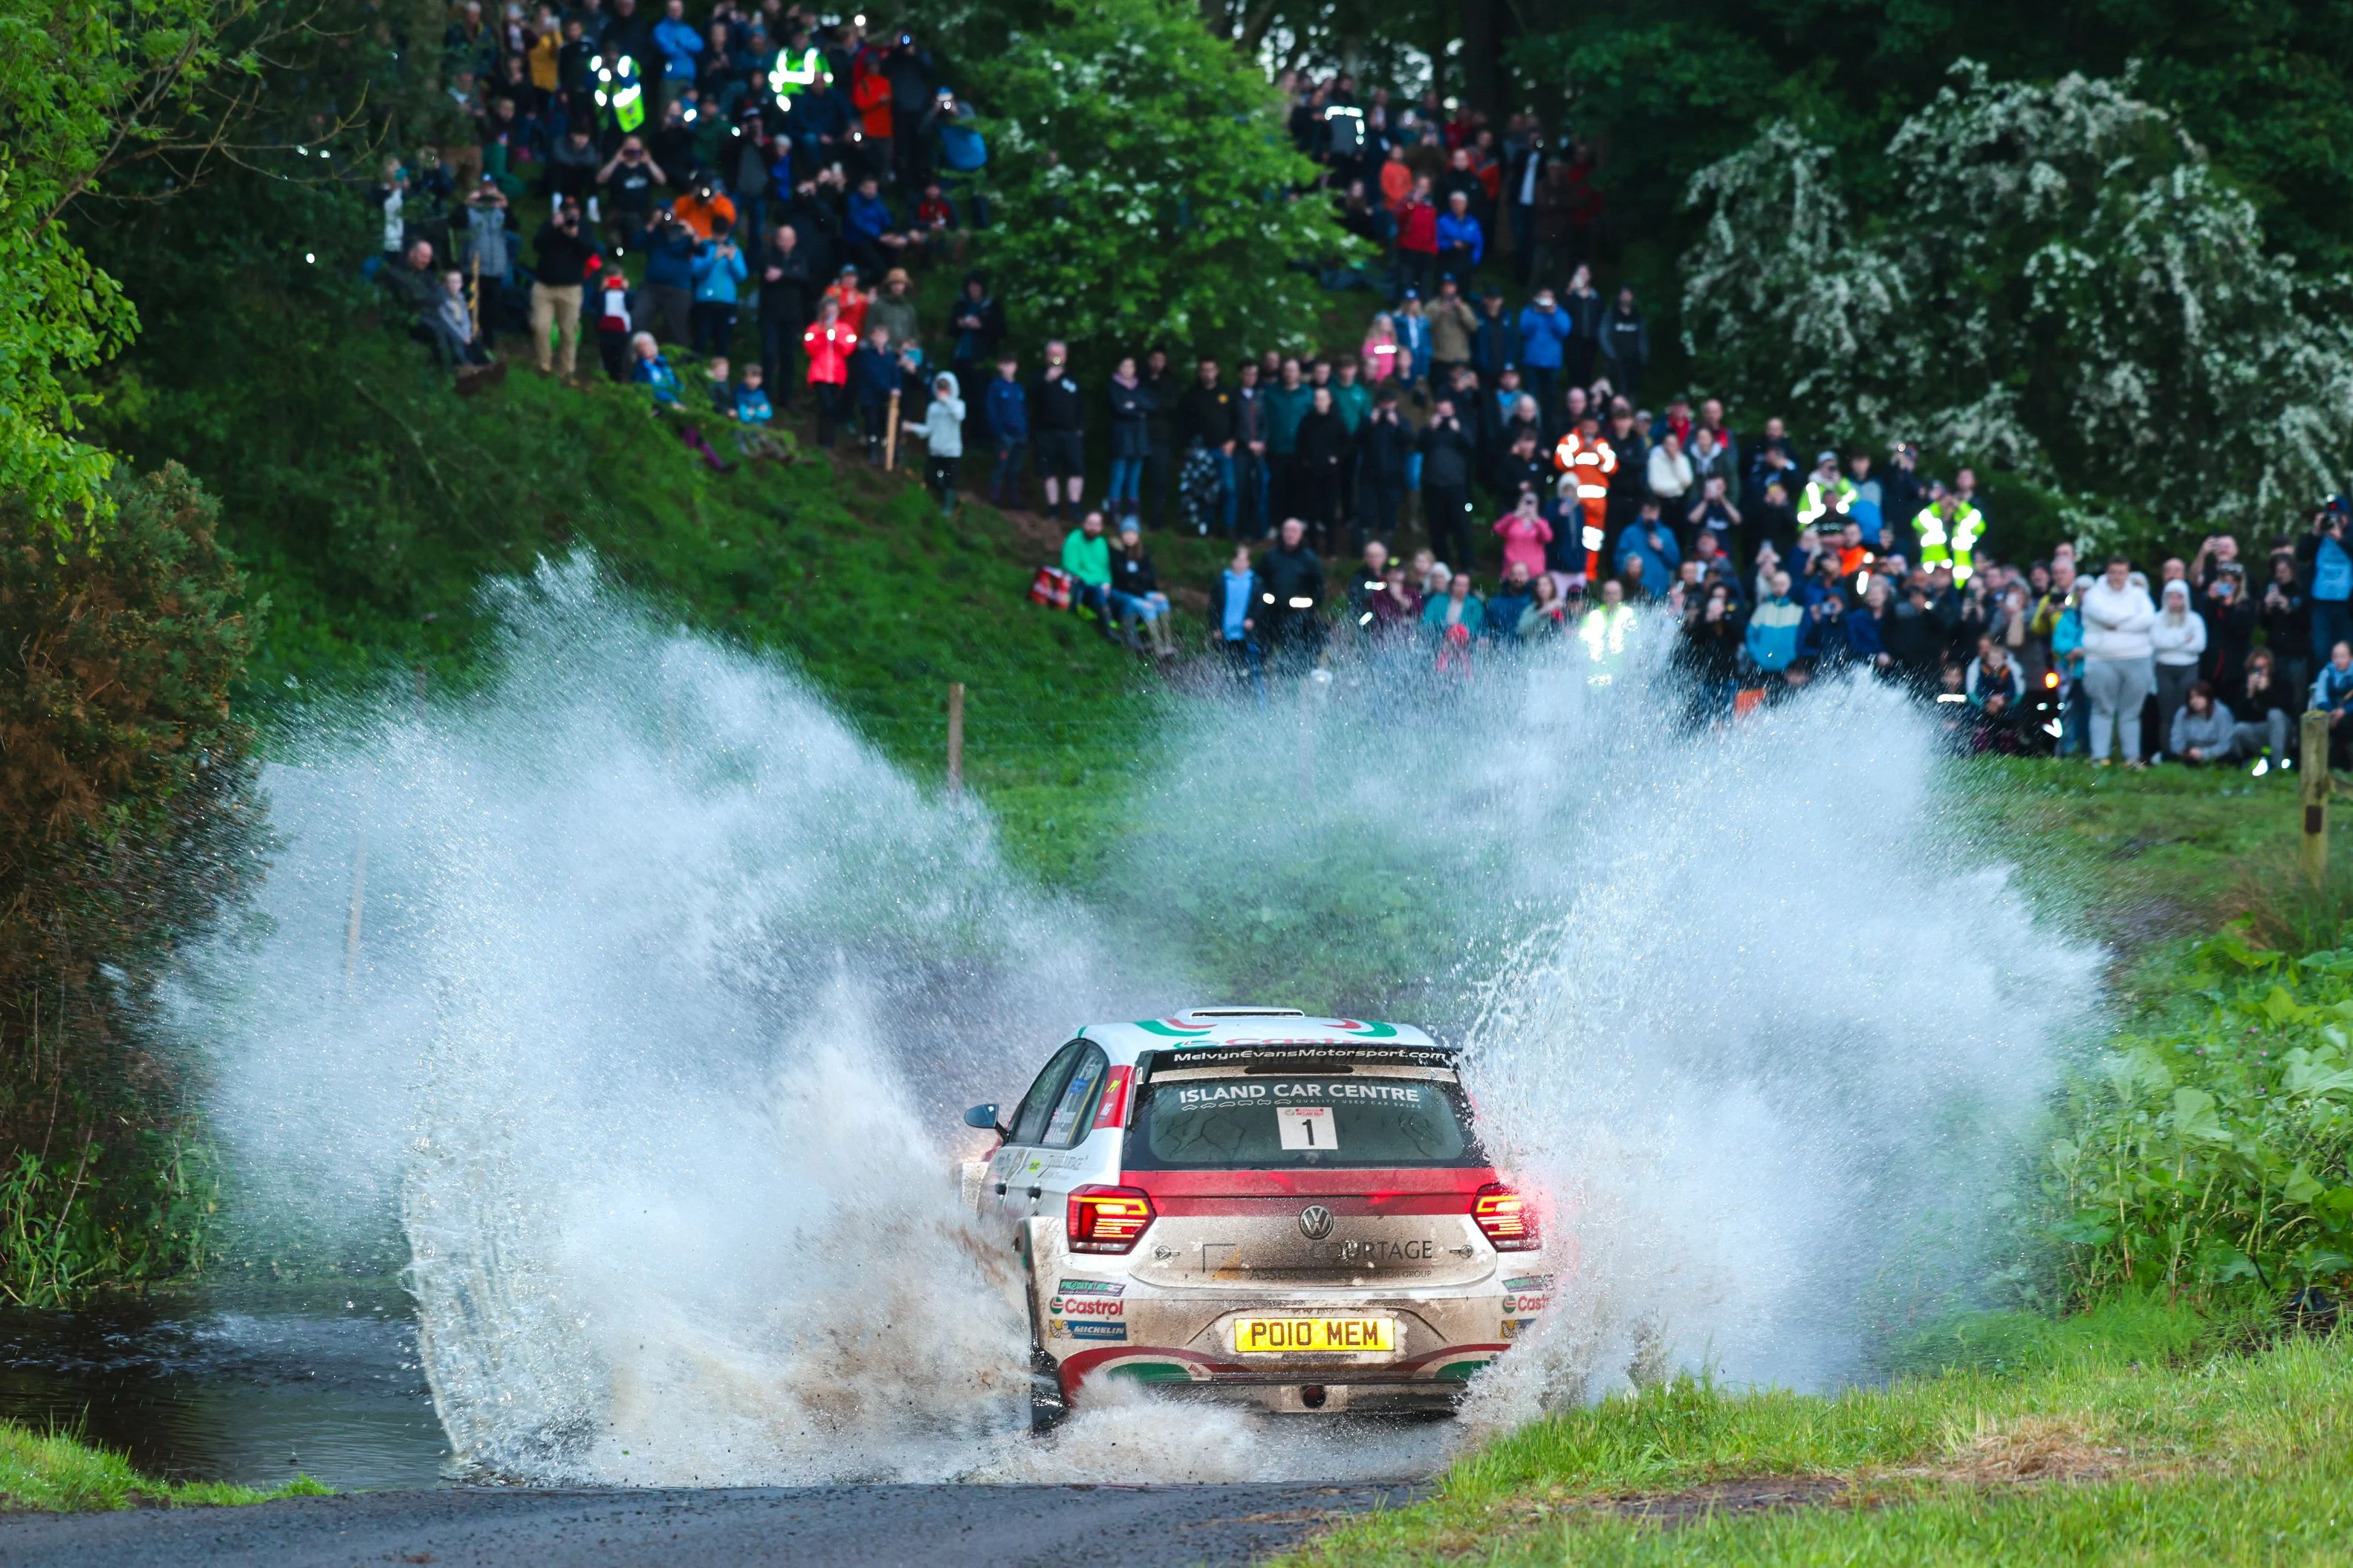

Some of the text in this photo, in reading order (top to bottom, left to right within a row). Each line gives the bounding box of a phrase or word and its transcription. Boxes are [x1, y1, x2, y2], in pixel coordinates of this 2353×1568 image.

[1173, 1050, 1447, 1061] MelvynEvansMotorsport.com
[1180, 1084, 1420, 1104] ISLAND CAR CENTRE
[1302, 1119, 1315, 1145] 1
[1403, 1270, 1432, 1278] GROUP
[1065, 1298, 1124, 1315] Castrol
[1074, 1326, 1124, 1335] MICHELIN
[1327, 1321, 1378, 1346] MEM
